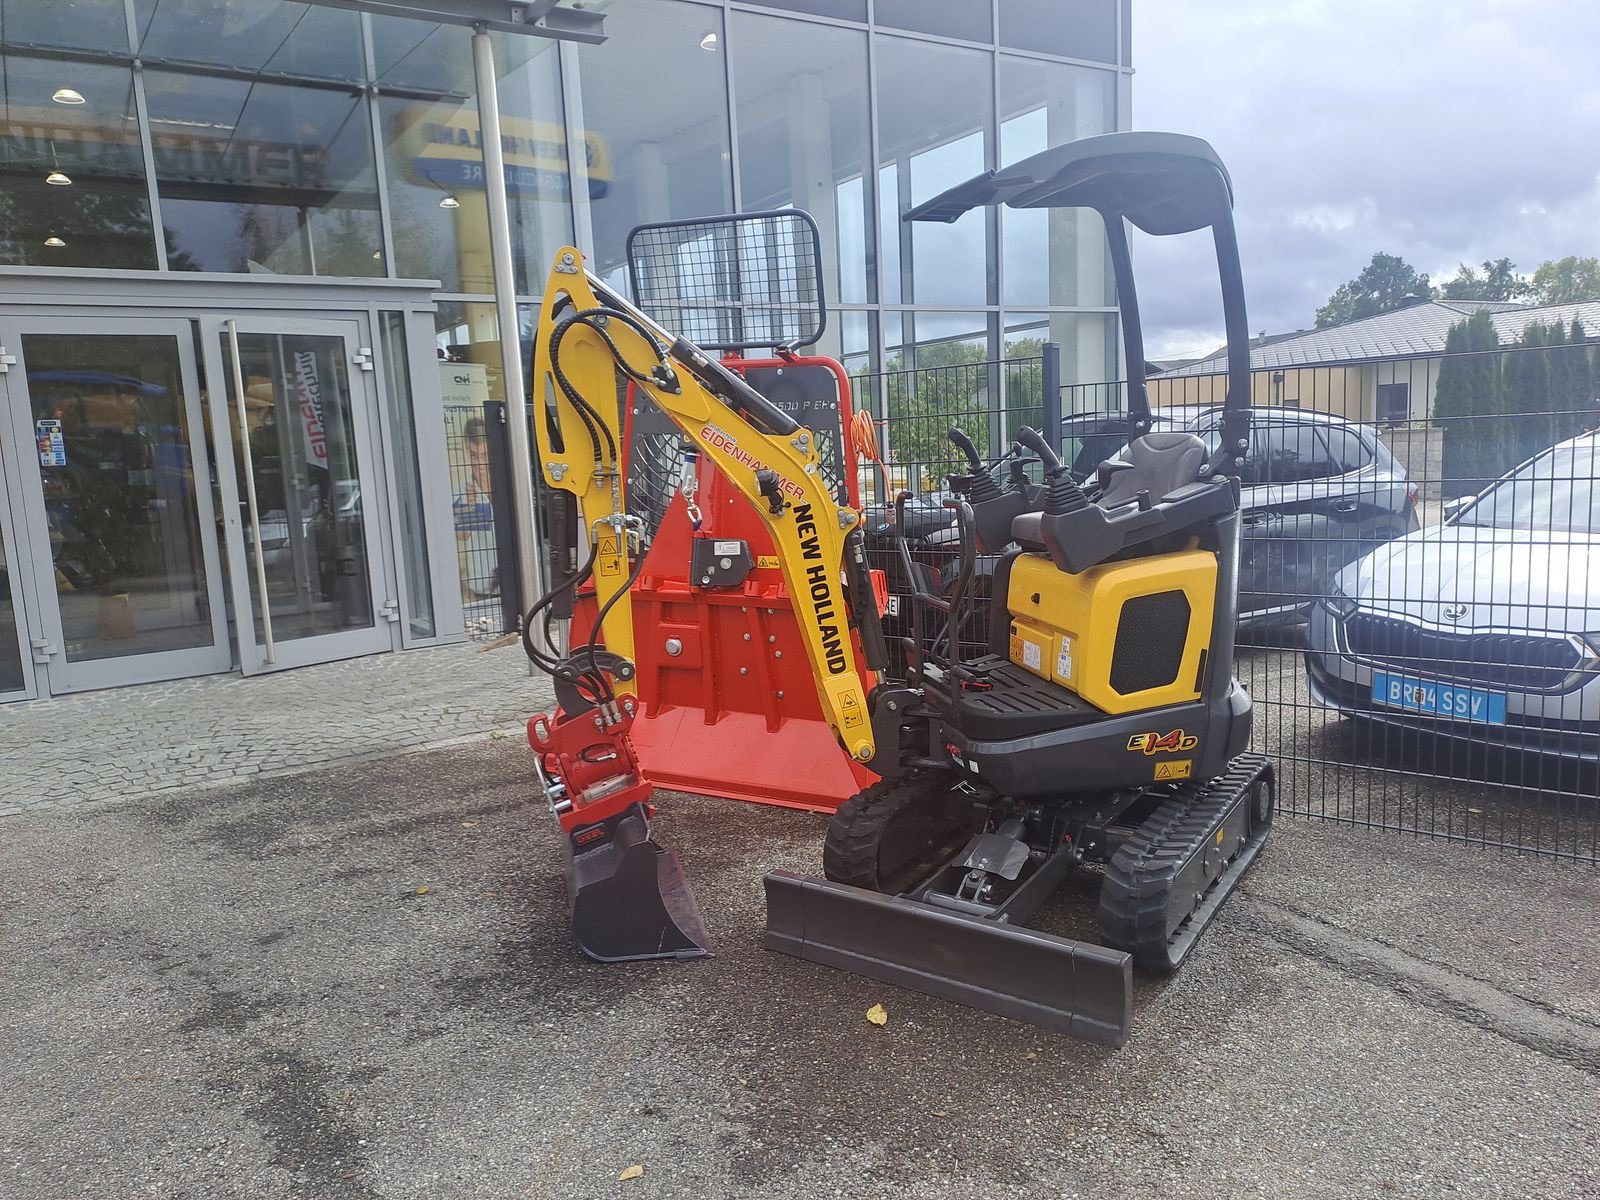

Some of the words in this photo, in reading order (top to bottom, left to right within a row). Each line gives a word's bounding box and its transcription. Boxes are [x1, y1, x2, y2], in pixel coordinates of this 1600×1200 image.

[803, 401, 810, 411] P
[814, 400, 830, 410] EH
[700, 426, 806, 501] EIDENHAMER
[793, 503, 822, 560] NEW
[806, 564, 847, 675] HOLLAND
[1442, 691, 1482, 716] SSV
[1127, 729, 1198, 755] E14D
